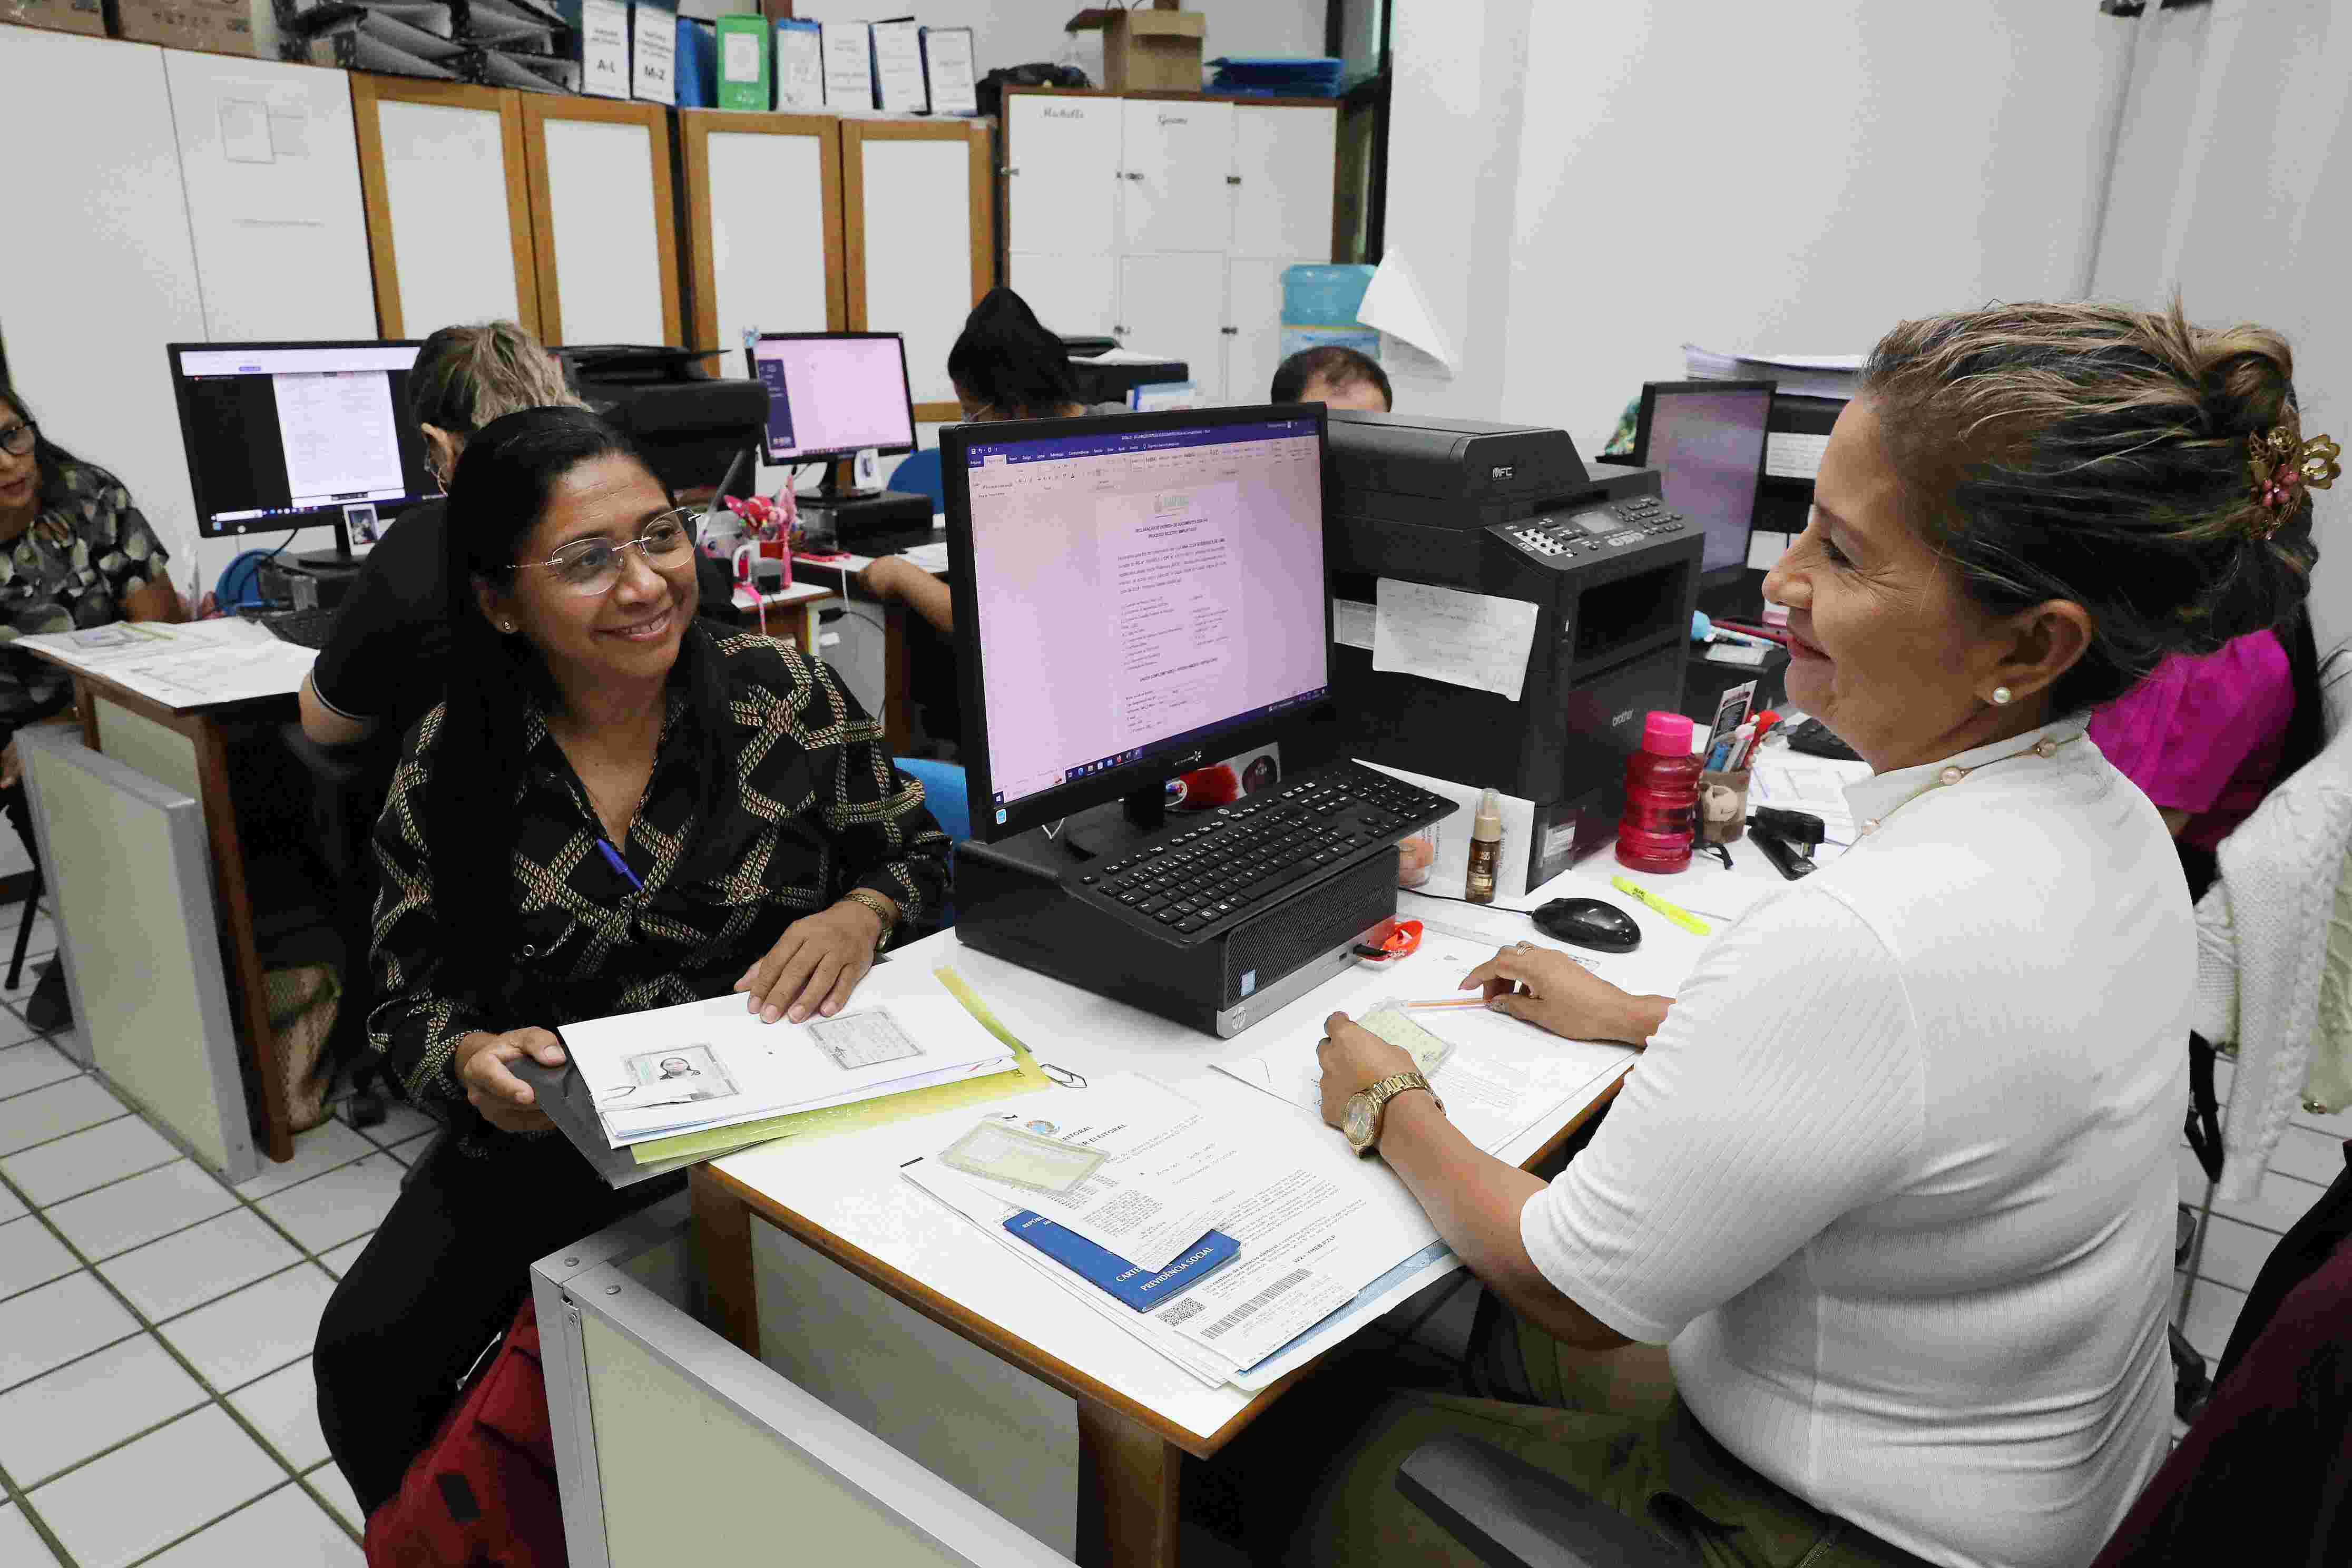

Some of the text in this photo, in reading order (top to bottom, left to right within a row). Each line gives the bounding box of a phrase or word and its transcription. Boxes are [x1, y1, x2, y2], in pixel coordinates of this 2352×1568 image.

[1492, 467, 1513, 478] MFC
[1089, 1124, 1128, 1143] ELEITORAL
[1140, 1247, 1214, 1292] PREVIDÊNCIA SOCIAL
